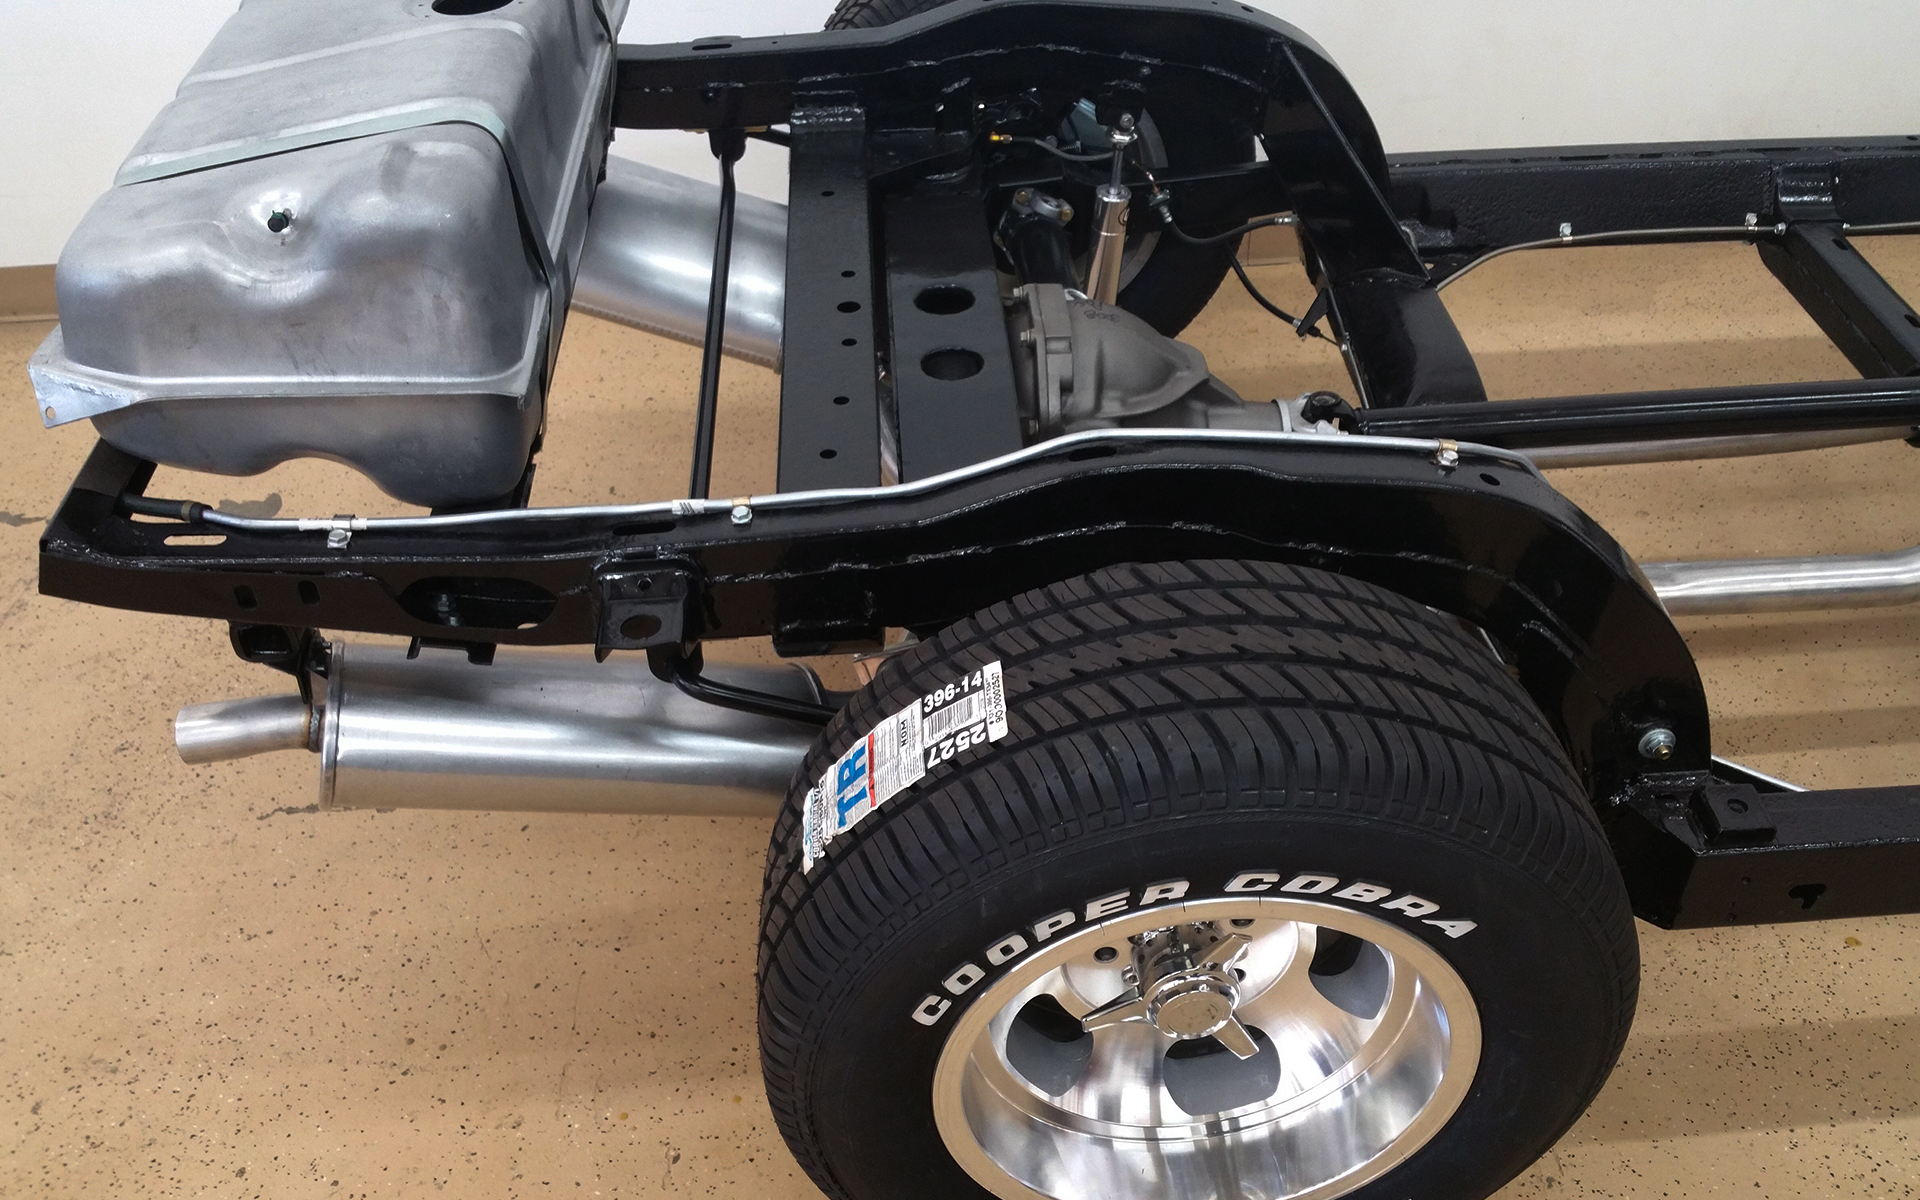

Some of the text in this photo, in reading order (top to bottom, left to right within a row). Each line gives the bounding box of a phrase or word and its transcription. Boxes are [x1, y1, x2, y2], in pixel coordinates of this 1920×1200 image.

[923, 670, 982, 713] 396-14
[900, 719, 908, 747] NOM
[927, 722, 986, 769] 2527
[911, 872, 1481, 1027] COOPER COBRA
